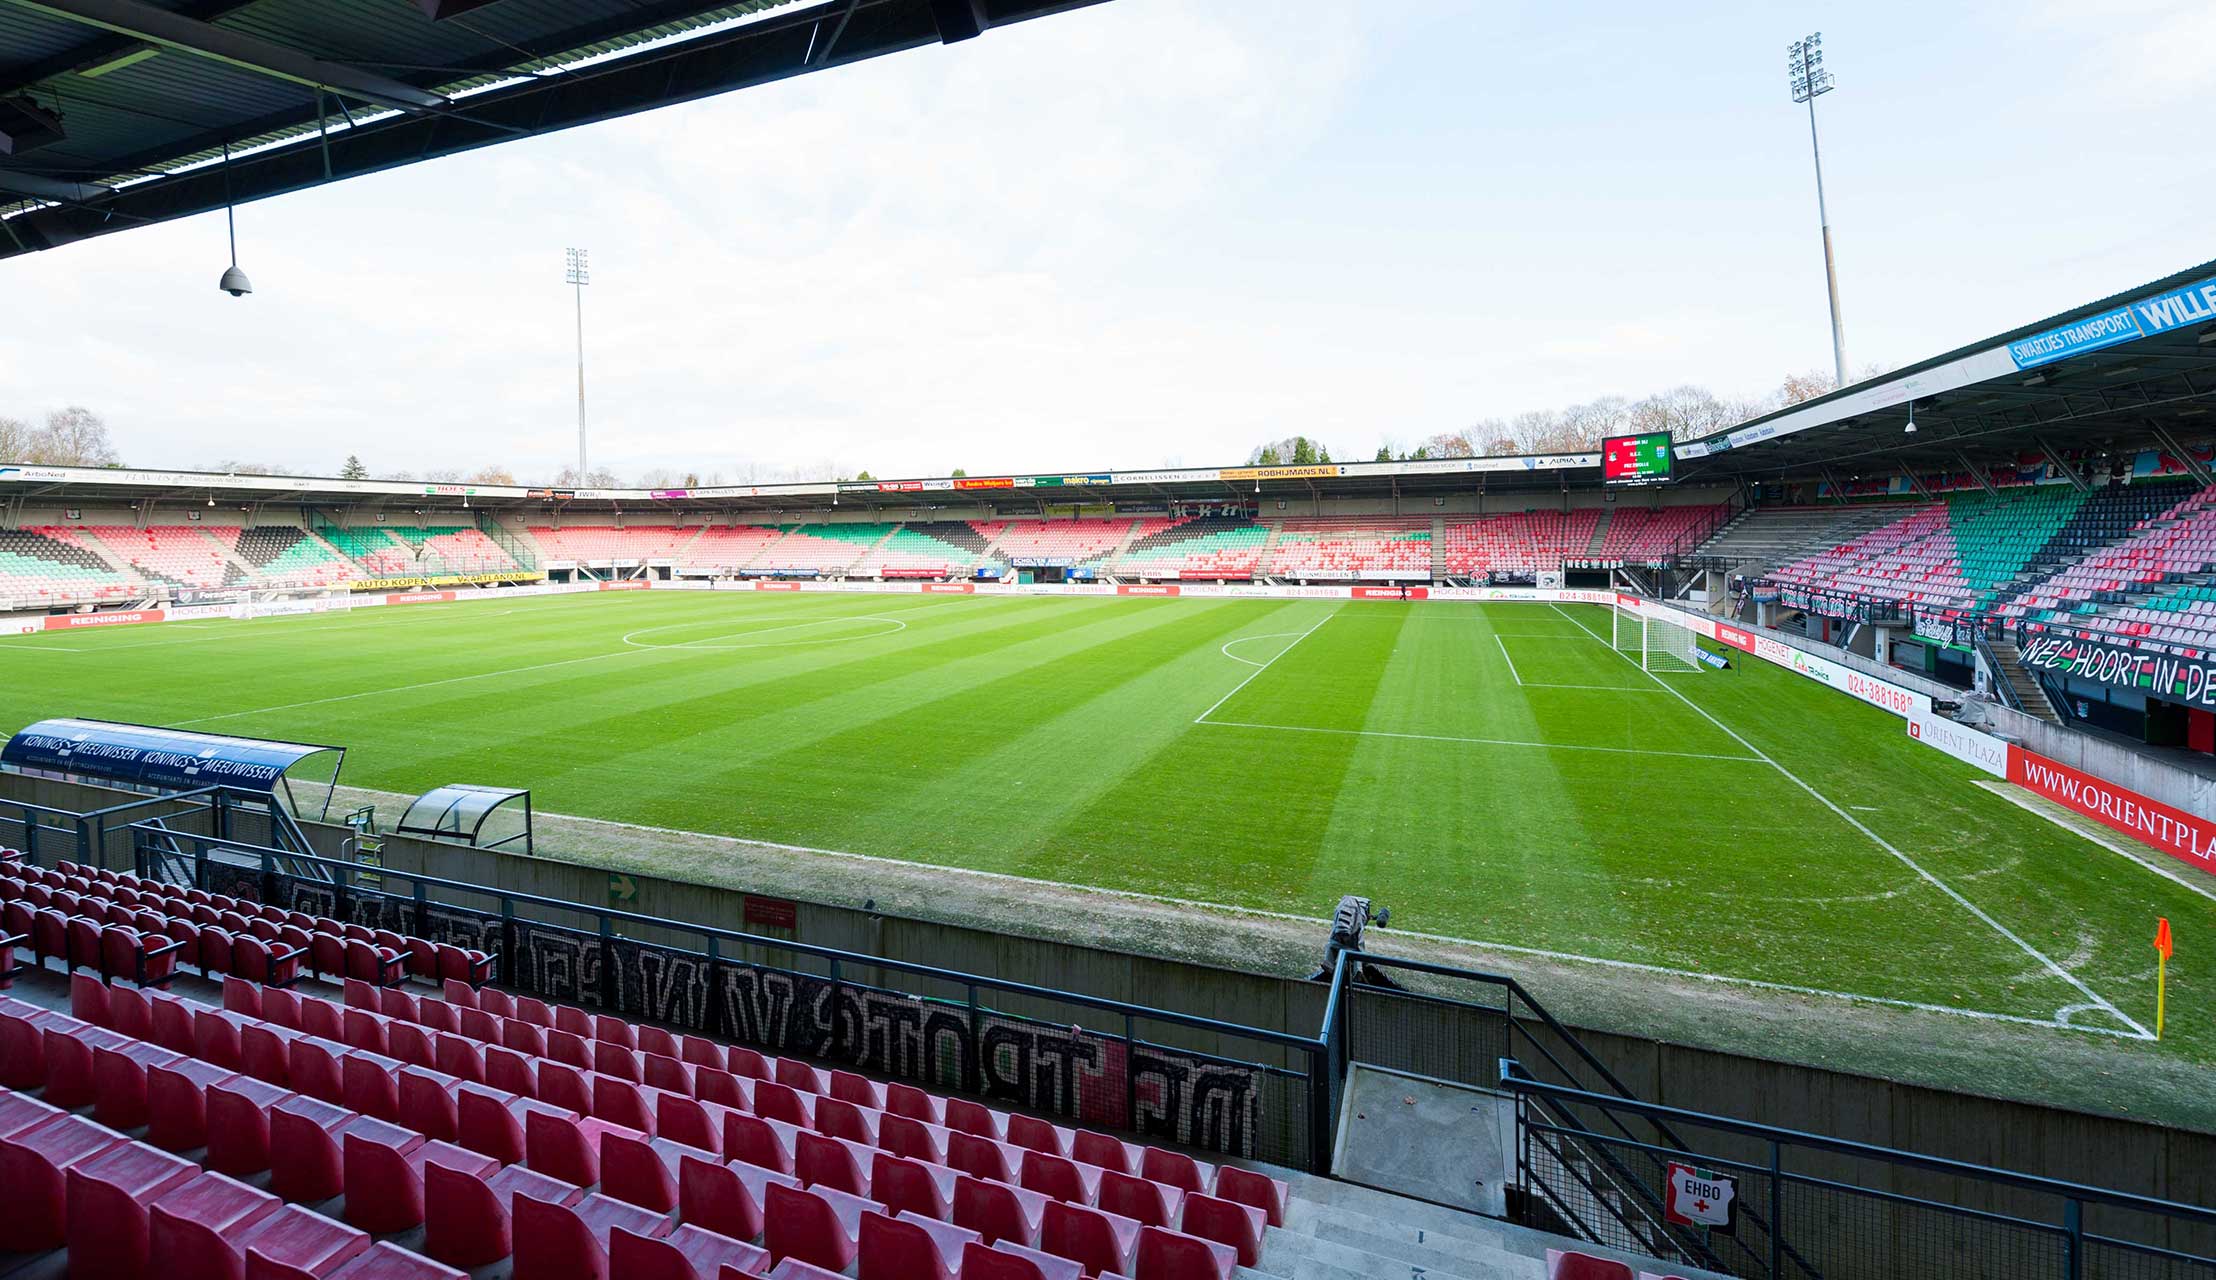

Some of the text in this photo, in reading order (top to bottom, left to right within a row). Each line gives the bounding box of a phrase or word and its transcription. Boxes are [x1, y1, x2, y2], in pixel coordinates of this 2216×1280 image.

[2014, 311, 2132, 361] SWARTJES TRANSPORT
[1550, 457, 1577, 465] ALPHA
[1063, 476, 1089, 484] makro
[1567, 559, 1589, 569] NEC
[1433, 588, 1483, 597] HOGENET
[71, 614, 142, 625] REINIGING
[171, 605, 233, 617] HOGENET
[1757, 639, 1790, 659] HOGENET
[2016, 637, 2216, 705] NEC HOORT IN DE
[22, 735, 142, 760] KONINGS MEEUWISSEN
[1924, 720, 2004, 769] ORIENT PLAZA
[141, 750, 280, 780] KONINGS MEEUWISSEN
[1684, 1179, 1721, 1201] EHBO
